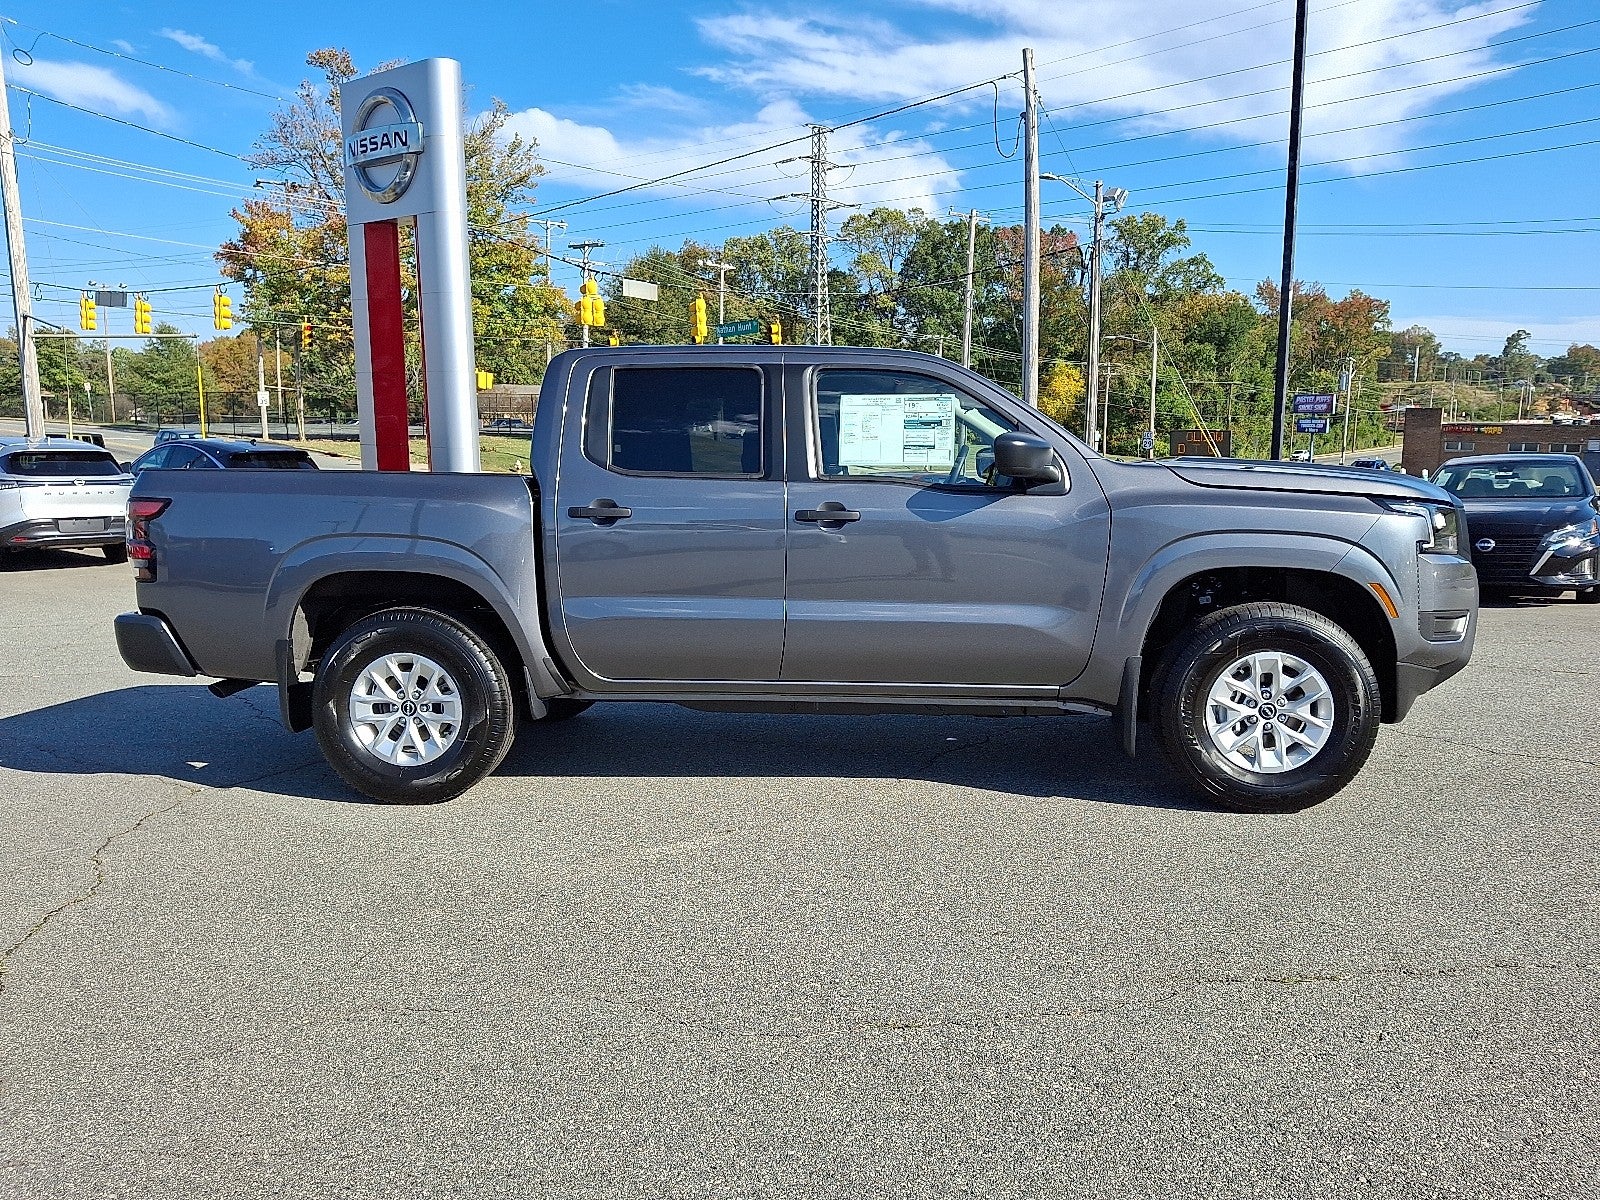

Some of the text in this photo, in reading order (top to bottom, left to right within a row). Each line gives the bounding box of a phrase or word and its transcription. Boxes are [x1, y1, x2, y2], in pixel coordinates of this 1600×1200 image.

[348, 129, 408, 159] NISSAN
[716, 325, 736, 334] Nathan
[737, 321, 752, 331] Hunt
[1143, 440, 1152, 448] 29
